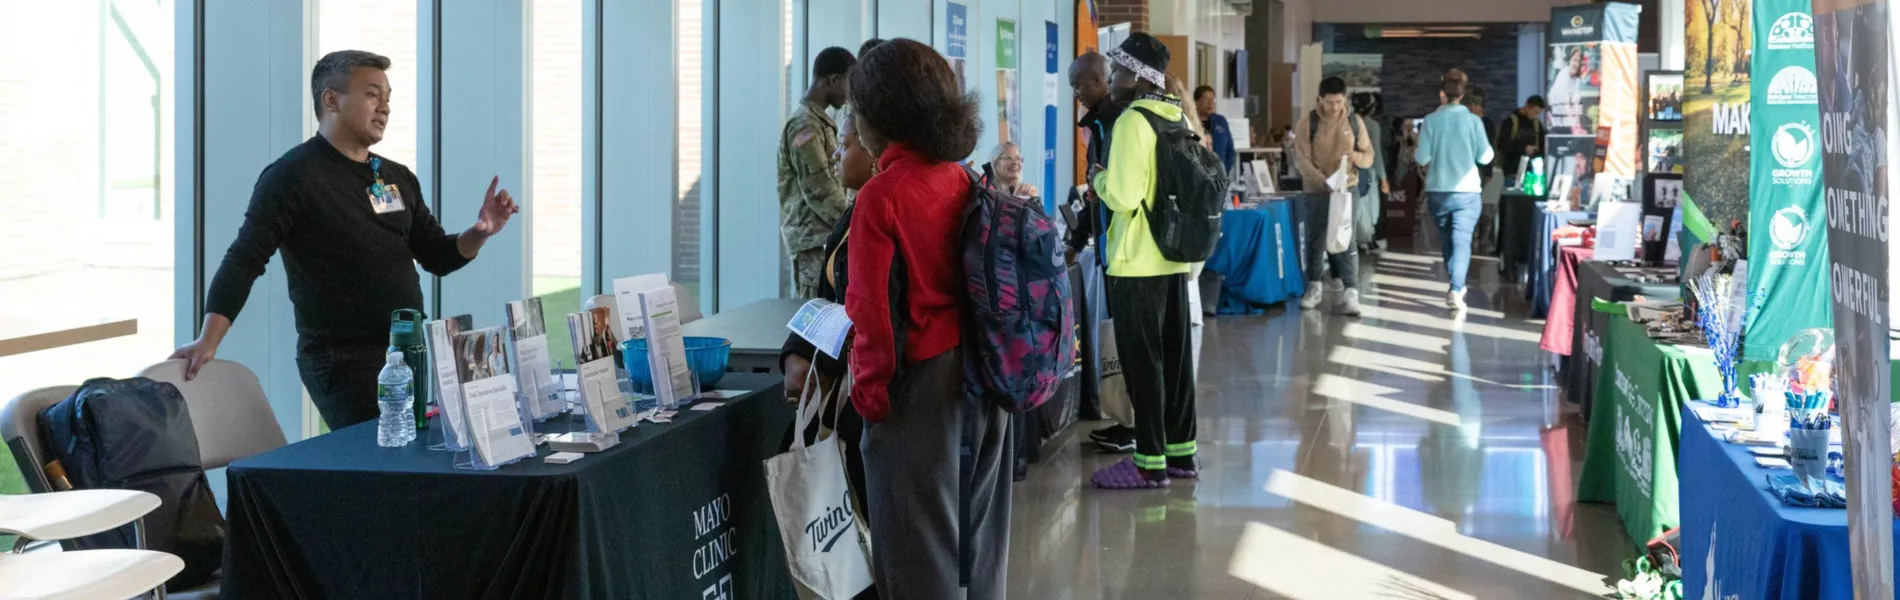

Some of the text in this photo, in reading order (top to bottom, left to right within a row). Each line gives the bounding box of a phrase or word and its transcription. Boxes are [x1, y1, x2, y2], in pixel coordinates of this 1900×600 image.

[1823, 111, 1852, 155] OING
[1772, 169, 1813, 178] GROWTH
[1833, 262, 1882, 325] OWERFUL
[693, 492, 731, 540] MAYO
[805, 506, 846, 553] Twin
[692, 526, 737, 580] CLINIC
